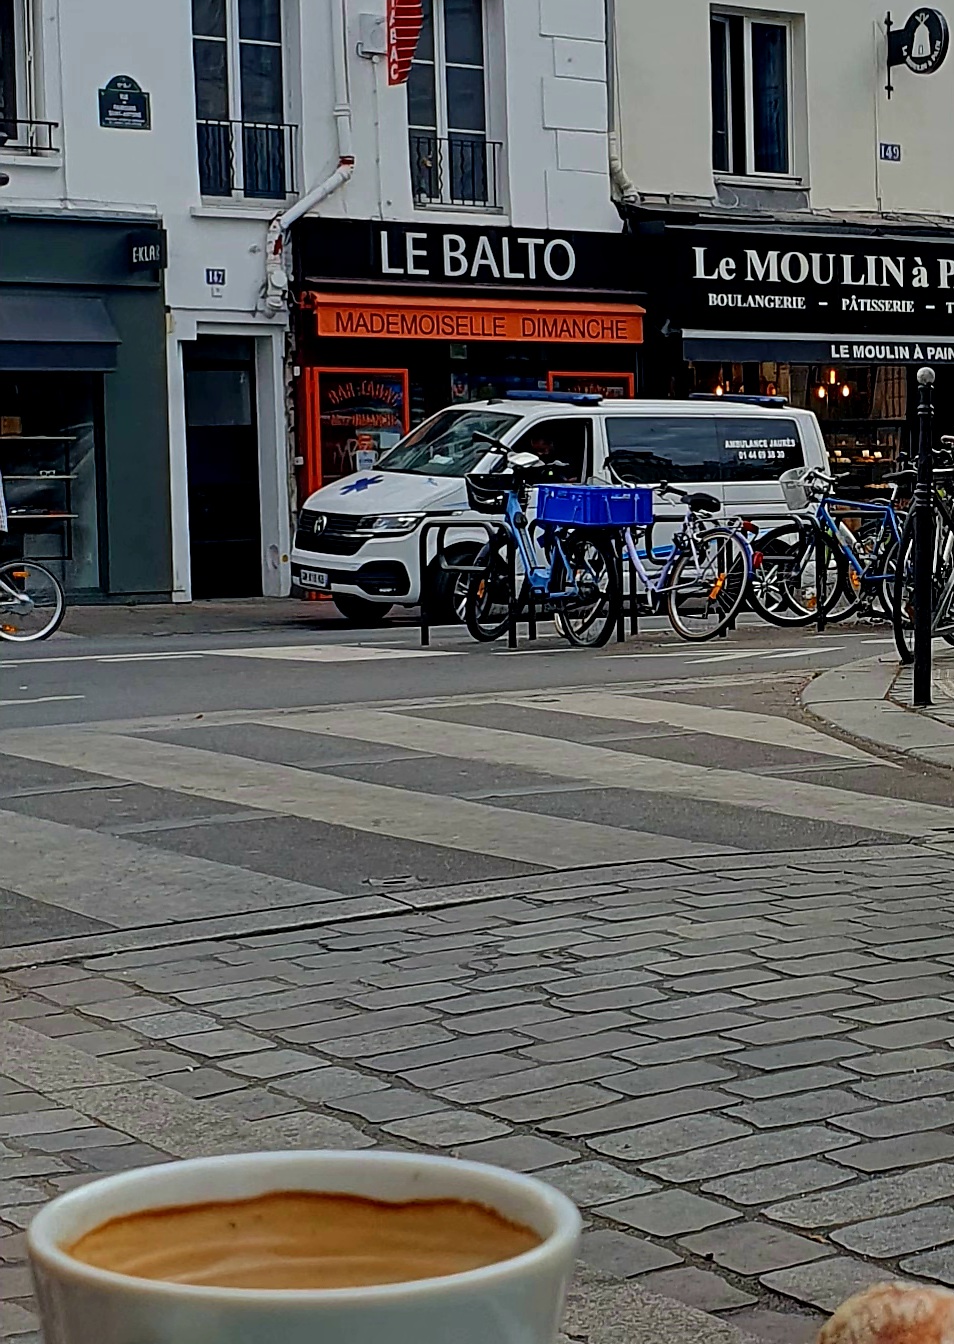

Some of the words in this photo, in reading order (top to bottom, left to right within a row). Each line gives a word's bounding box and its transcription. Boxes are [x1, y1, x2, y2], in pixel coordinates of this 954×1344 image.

[881, 145, 899, 159] 149
[380, 231, 429, 275] LE
[443, 233, 577, 281] BALTO
[692, 246, 736, 280] Le
[743, 249, 906, 288] MOULIN
[911, 257, 929, 288] à
[708, 293, 806, 310] BOULANGERIE
[841, 294, 915, 313] PÂTISSERIE
[335, 312, 507, 338] MADEMOISELLE
[522, 316, 628, 339] DIMANCHE
[831, 345, 850, 358] LE
[852, 345, 909, 360] MOULIN
[913, 343, 924, 359] À
